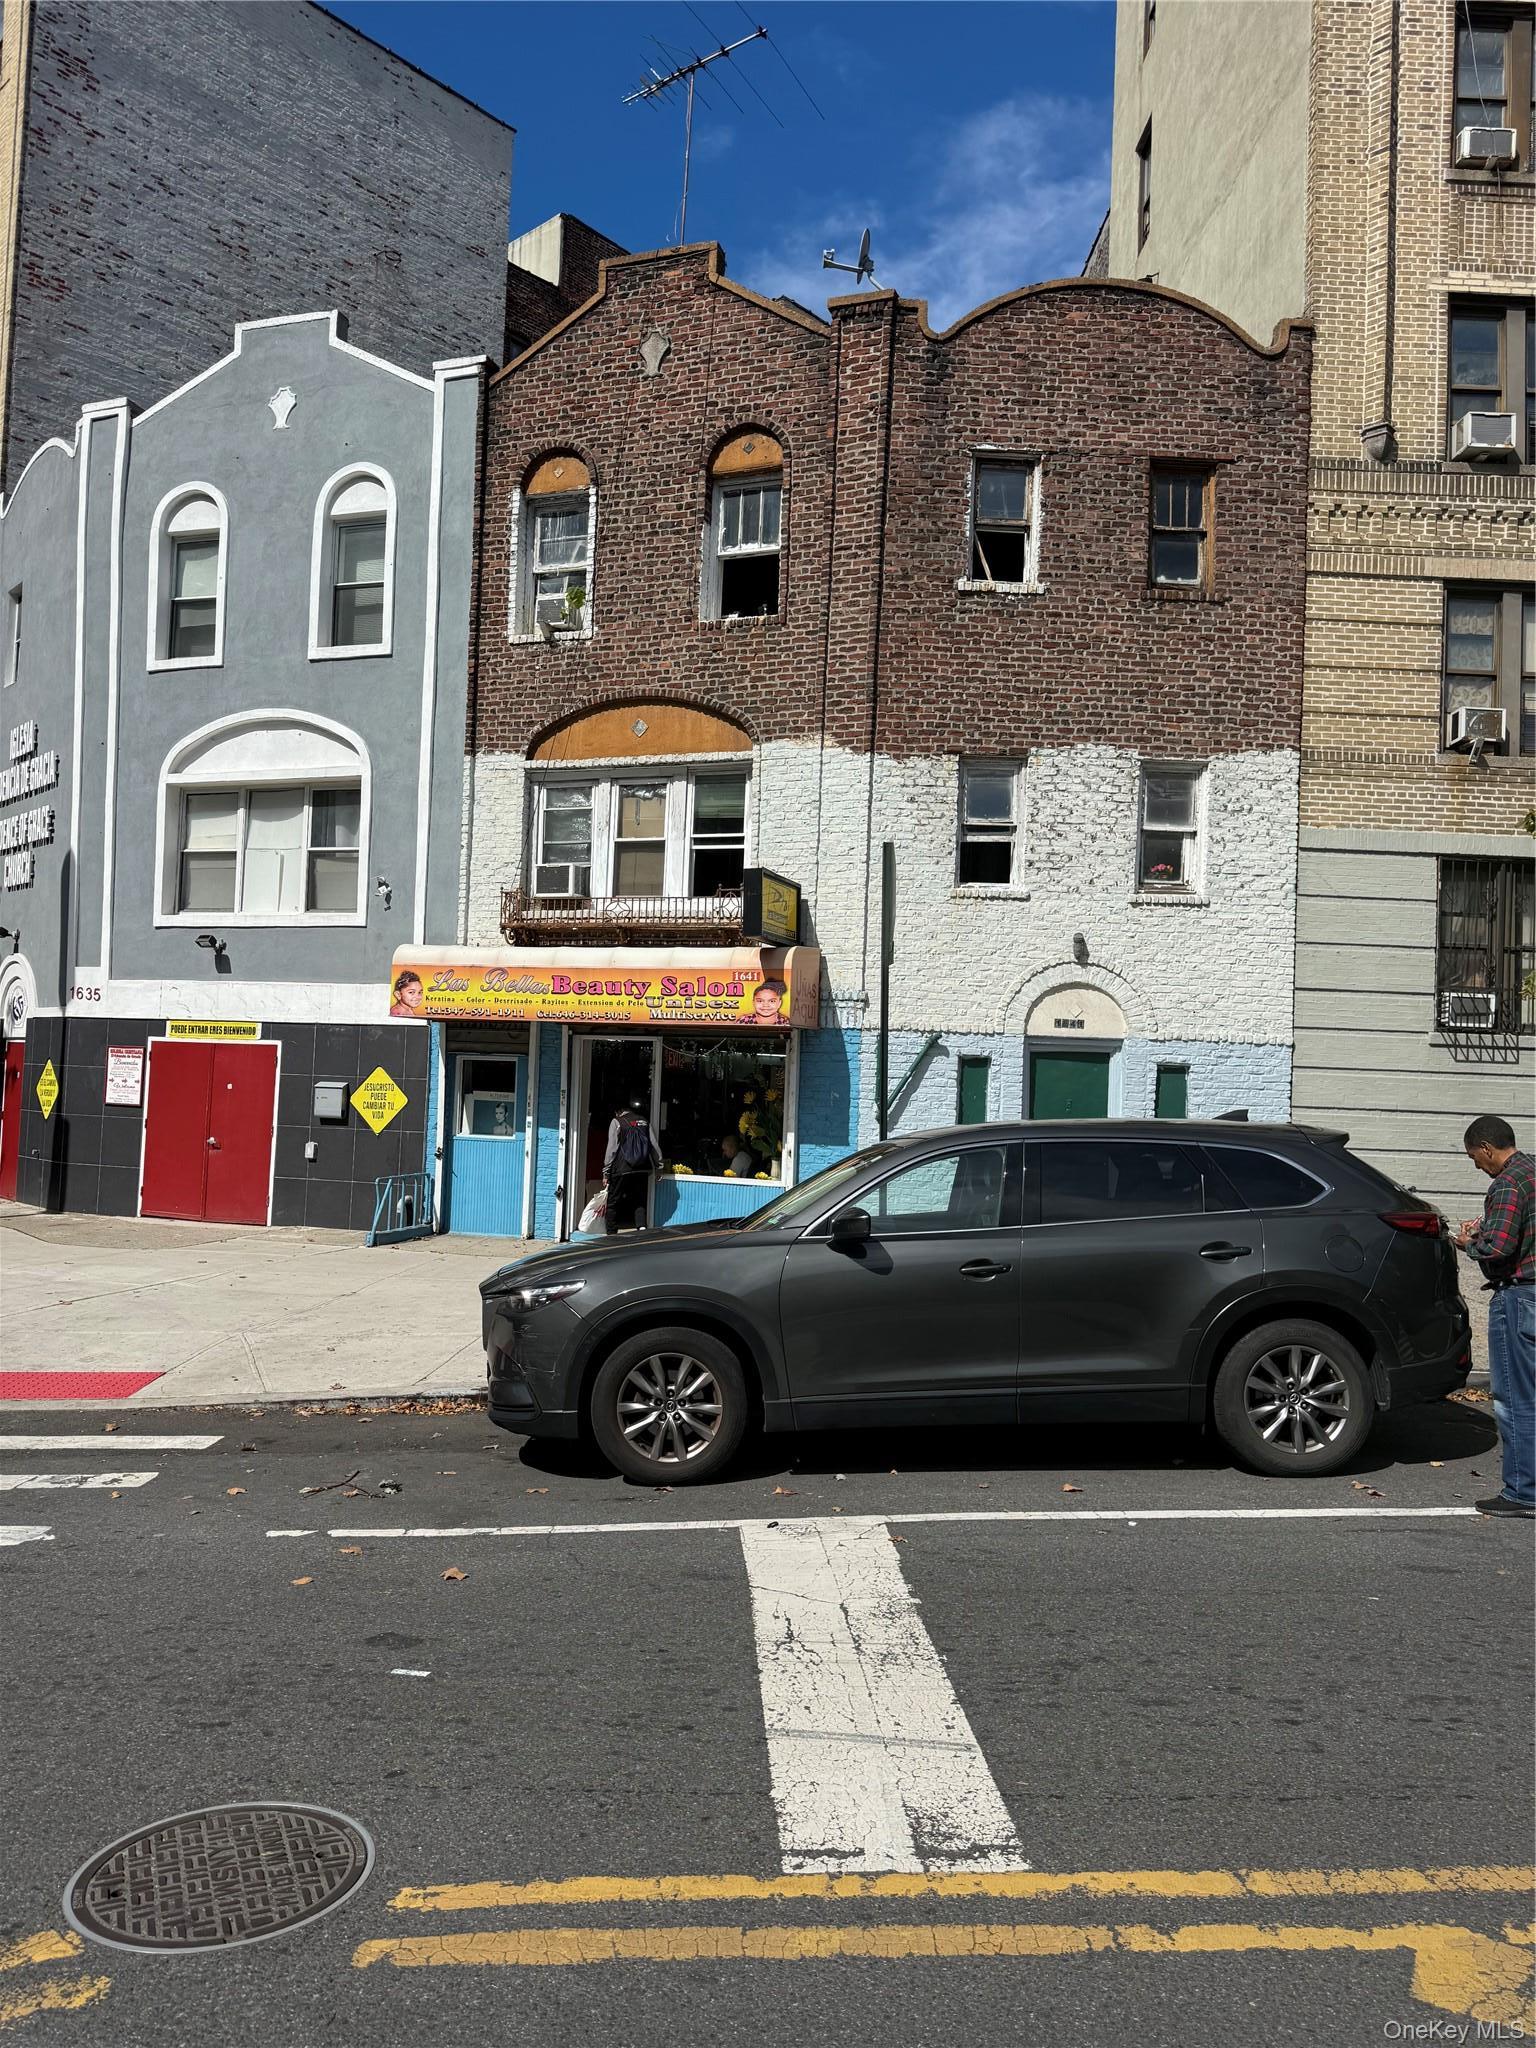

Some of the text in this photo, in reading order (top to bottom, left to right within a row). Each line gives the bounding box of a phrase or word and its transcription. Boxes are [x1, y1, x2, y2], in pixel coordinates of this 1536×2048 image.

[9, 719, 34, 760] IGLESIA
[20, 760, 30, 796] DE
[29, 750, 55, 792] GRACIA
[18, 812, 28, 846] OF
[28, 804, 50, 843] GRACE
[4, 850, 31, 888] CHURCH
[427, 967, 745, 998] Las Bellas Beauty Salon
[734, 971, 758, 981] 1641
[70, 986, 101, 1001] 1635
[645, 995, 740, 1009] Unisex
[649, 1008, 737, 1021] Multiservice
[170, 1024, 256, 1036] PUEDE ENTRAR ERES BIENVENIDO
[363, 1083, 394, 1092] JESUCRISTO
[370, 1092, 387, 1101] PUEDE
[362, 1101, 394, 1111] CAMBIAR TU
[372, 1111, 384, 1120] VIDA
